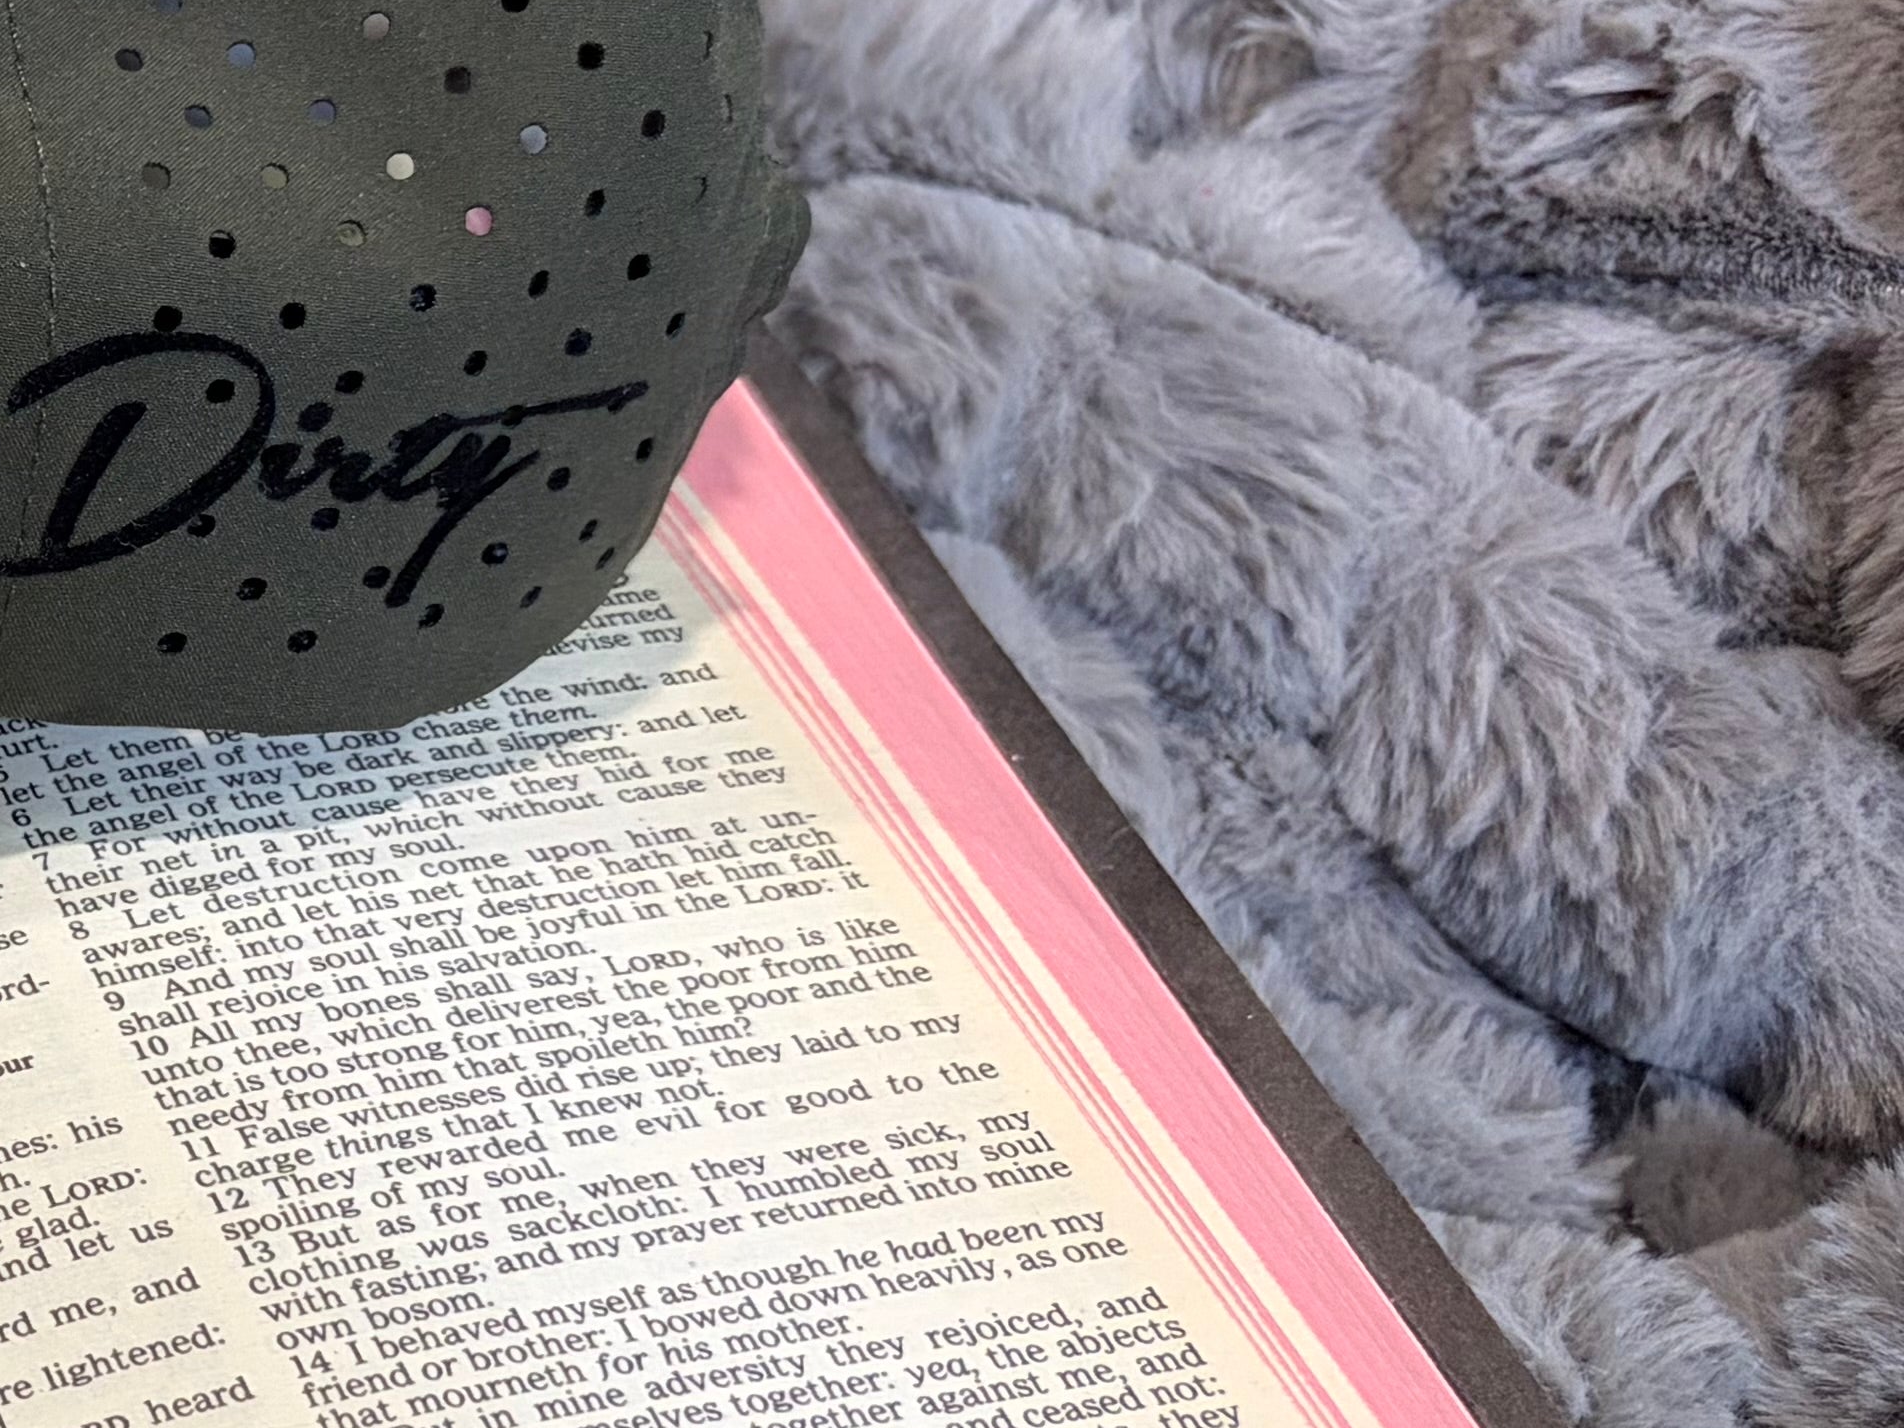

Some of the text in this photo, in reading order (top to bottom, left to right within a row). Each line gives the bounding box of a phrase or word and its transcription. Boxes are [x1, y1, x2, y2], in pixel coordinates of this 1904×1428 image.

[9, 704, 747, 827] 6 Let their way be dark and slippery: and let
